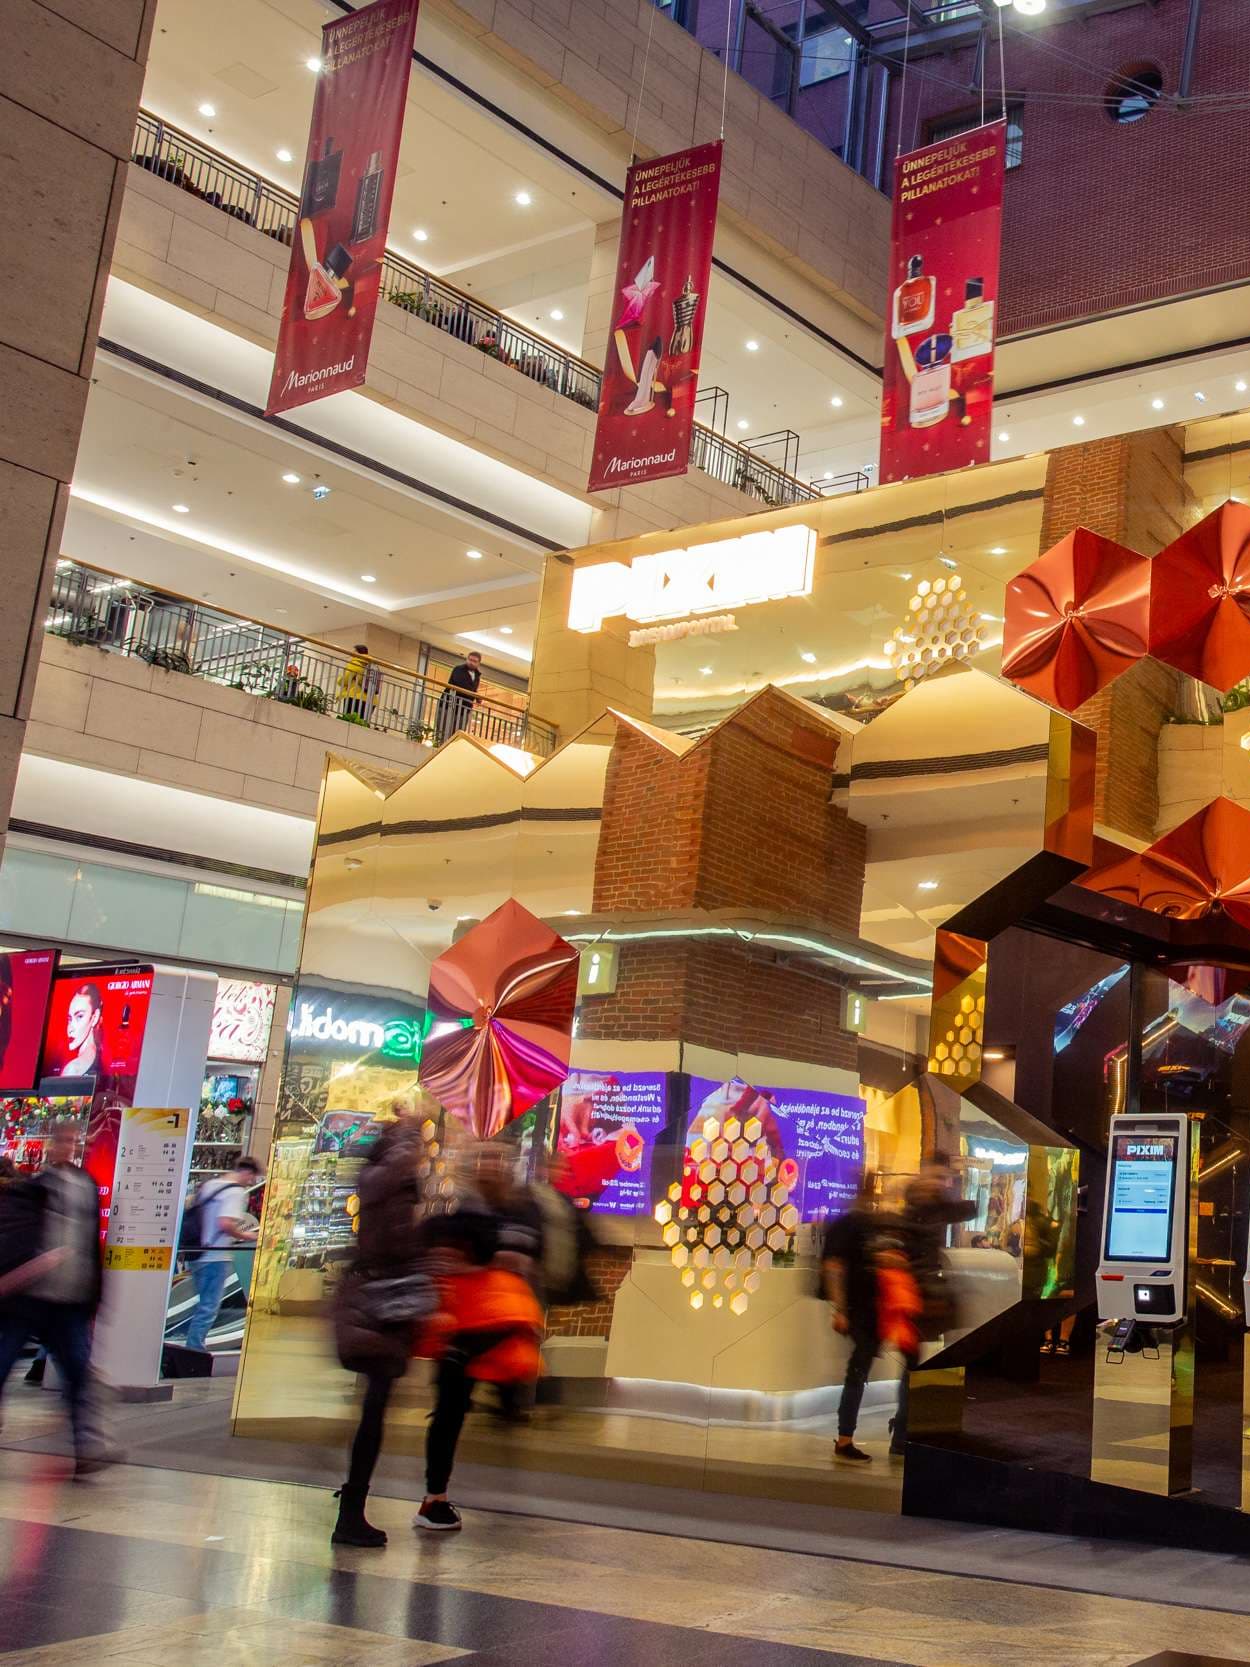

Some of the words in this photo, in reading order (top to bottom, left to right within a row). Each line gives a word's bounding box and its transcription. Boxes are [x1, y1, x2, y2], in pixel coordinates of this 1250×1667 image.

[636, 157, 690, 181] ÜNNEPELJÜK
[901, 178, 909, 188] A
[911, 146, 997, 185] LEGÉRTÉKESEBB
[902, 142, 968, 173] ÜNNEPELJÜK
[633, 186, 640, 195] A
[641, 163, 716, 193] LEGÉRTÉKESEBB
[281, 354, 355, 397] Marionnaud
[604, 448, 676, 479] Marionnaud
[168, 1113, 180, 1129] -1
[1127, 1145, 1164, 1155] PIXIM
